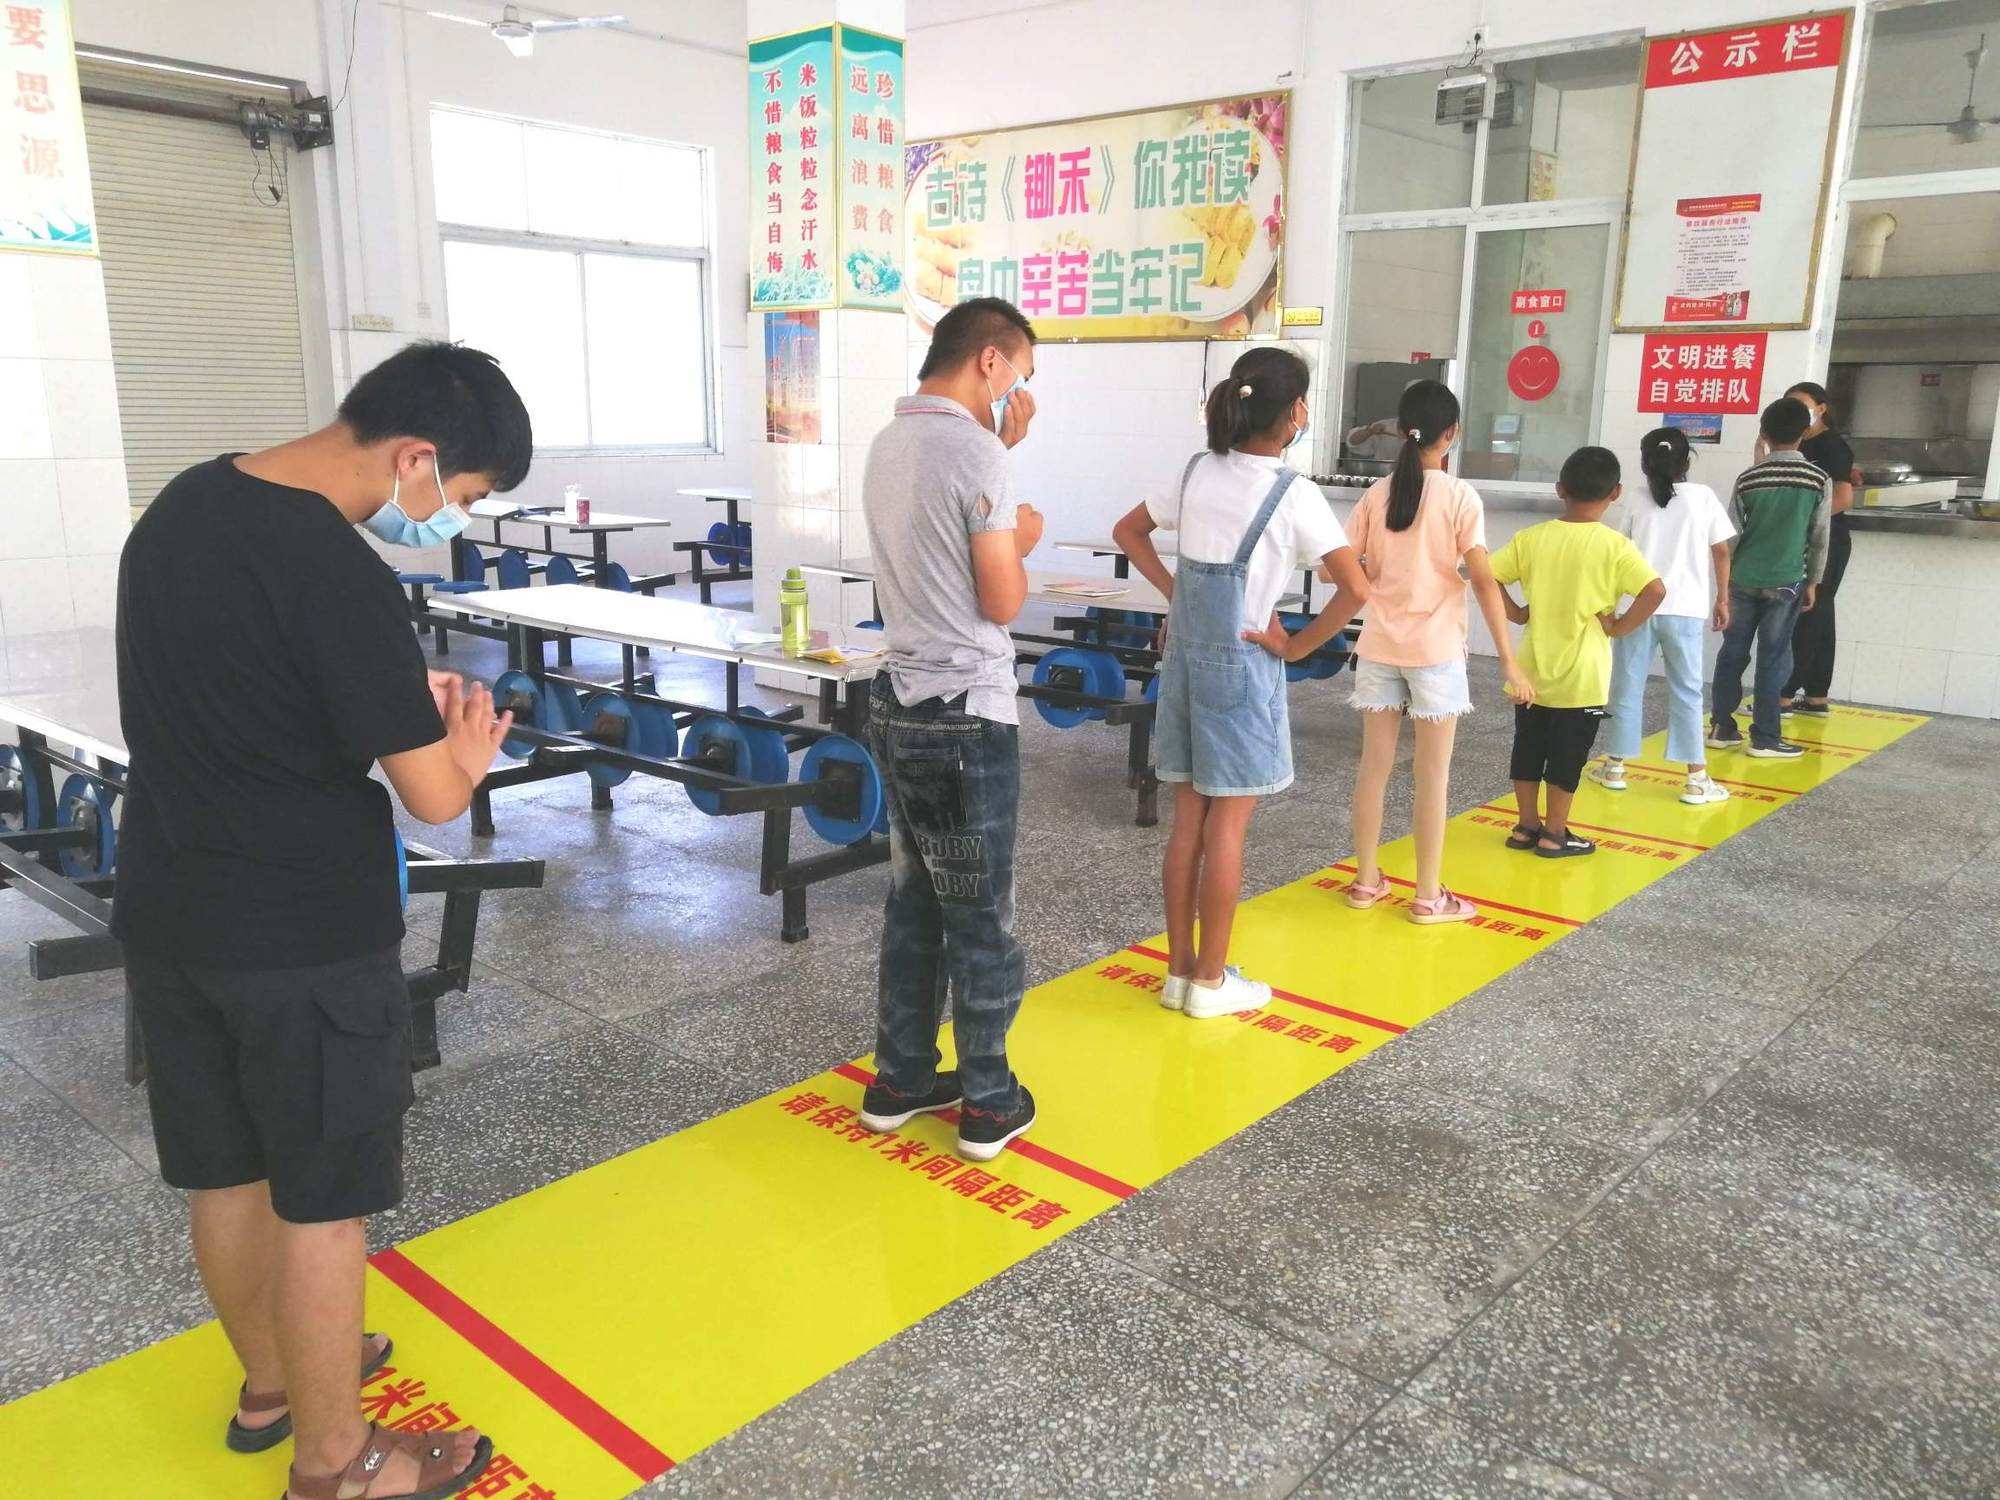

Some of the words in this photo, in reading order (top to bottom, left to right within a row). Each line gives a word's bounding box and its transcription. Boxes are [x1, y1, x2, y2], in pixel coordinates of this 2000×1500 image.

[1670, 23, 1822, 75] 公示栏
[764, 69, 784, 273] 不惜粮食当自悔
[799, 63, 819, 271] 米饭粒粒念汗水
[850, 65, 869, 233] 远离浪费
[875, 73, 895, 234] 珍惜粮食
[1515, 294, 1563, 309] 副食窗口
[1651, 344, 1756, 370] 文明进餐
[1650, 377, 1751, 404] 自觉排队
[779, 1091, 1072, 1231] 请保持1米间隔距离
